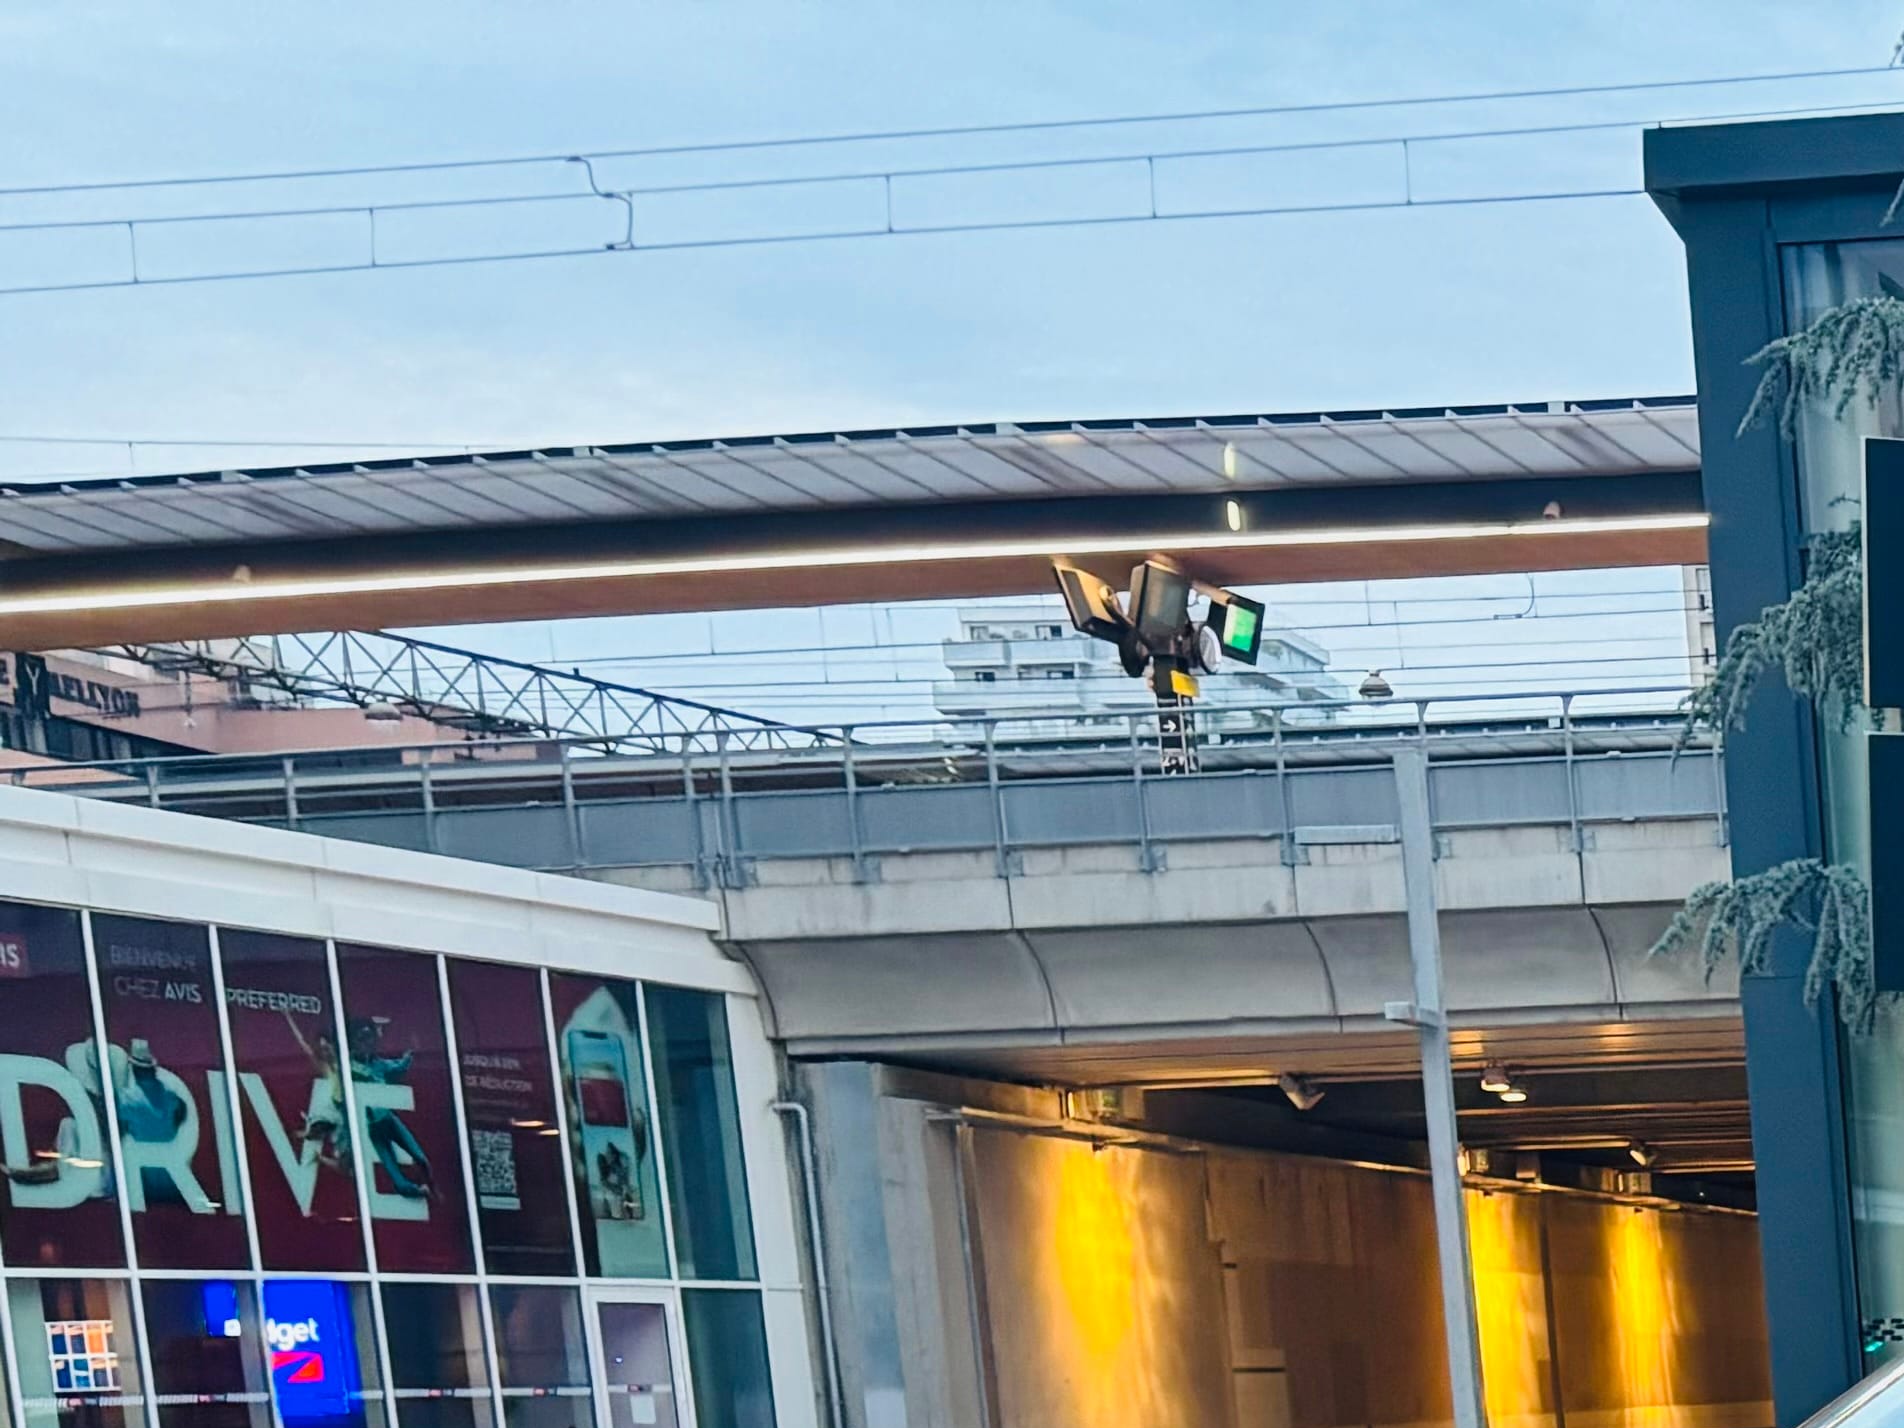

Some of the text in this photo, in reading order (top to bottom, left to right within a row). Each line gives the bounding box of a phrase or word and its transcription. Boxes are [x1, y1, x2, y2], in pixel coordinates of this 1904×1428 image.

[114, 975, 322, 1015] CHEZ AVIS PREFERRED
[0, 1053, 430, 1222] DRIVE
